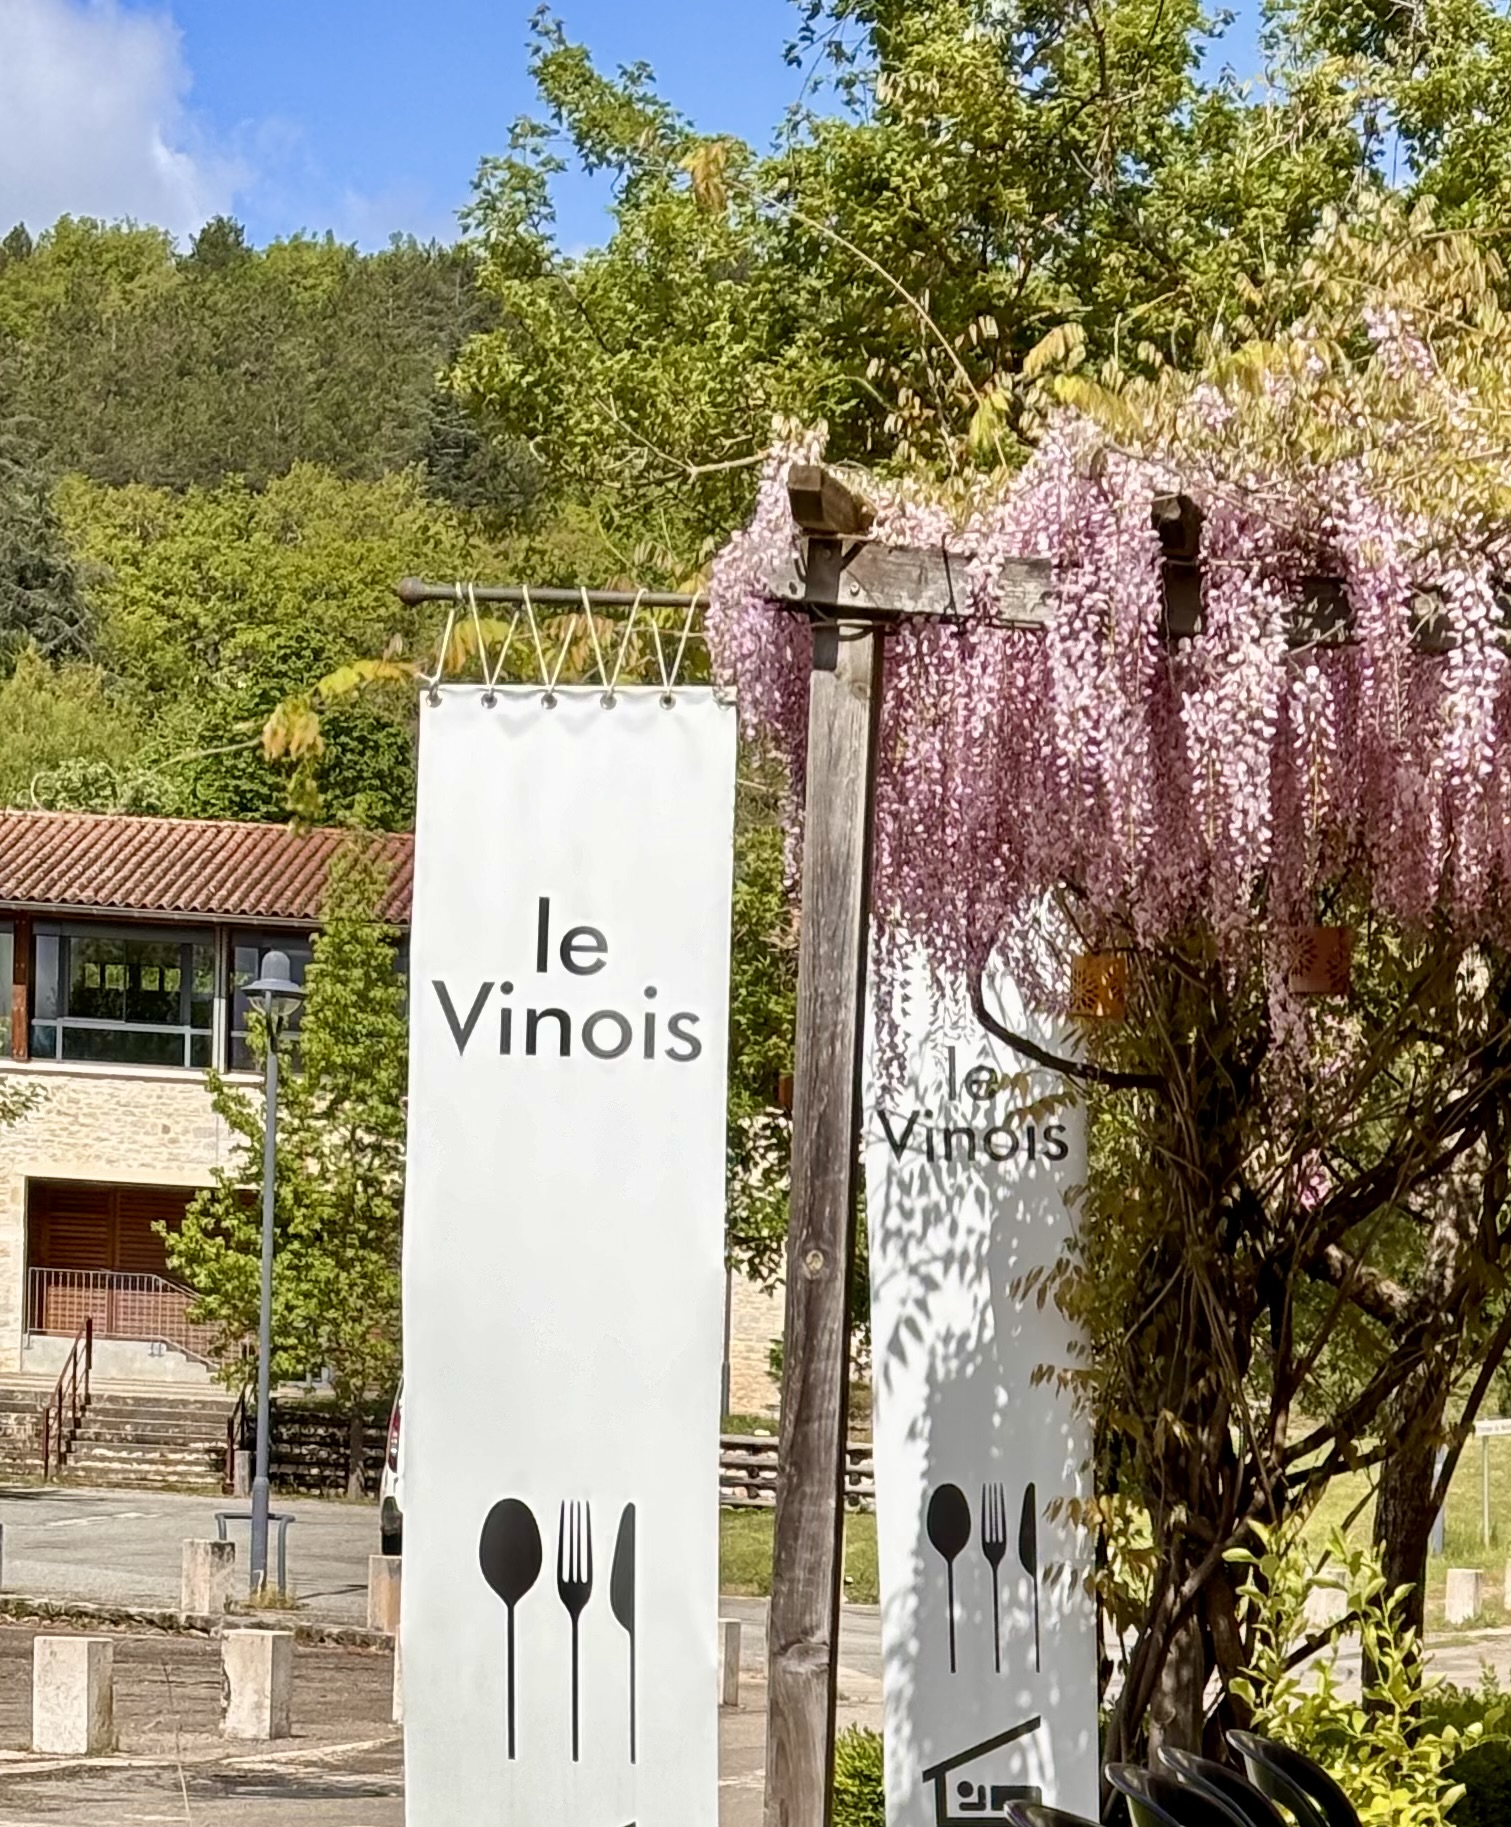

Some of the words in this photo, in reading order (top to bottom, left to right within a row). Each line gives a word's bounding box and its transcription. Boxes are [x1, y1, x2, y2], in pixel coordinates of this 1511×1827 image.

[536, 895, 609, 976] le
[431, 980, 703, 1063] Vinois
[947, 1045, 999, 1101] le
[877, 1108, 1069, 1163] Vinois
